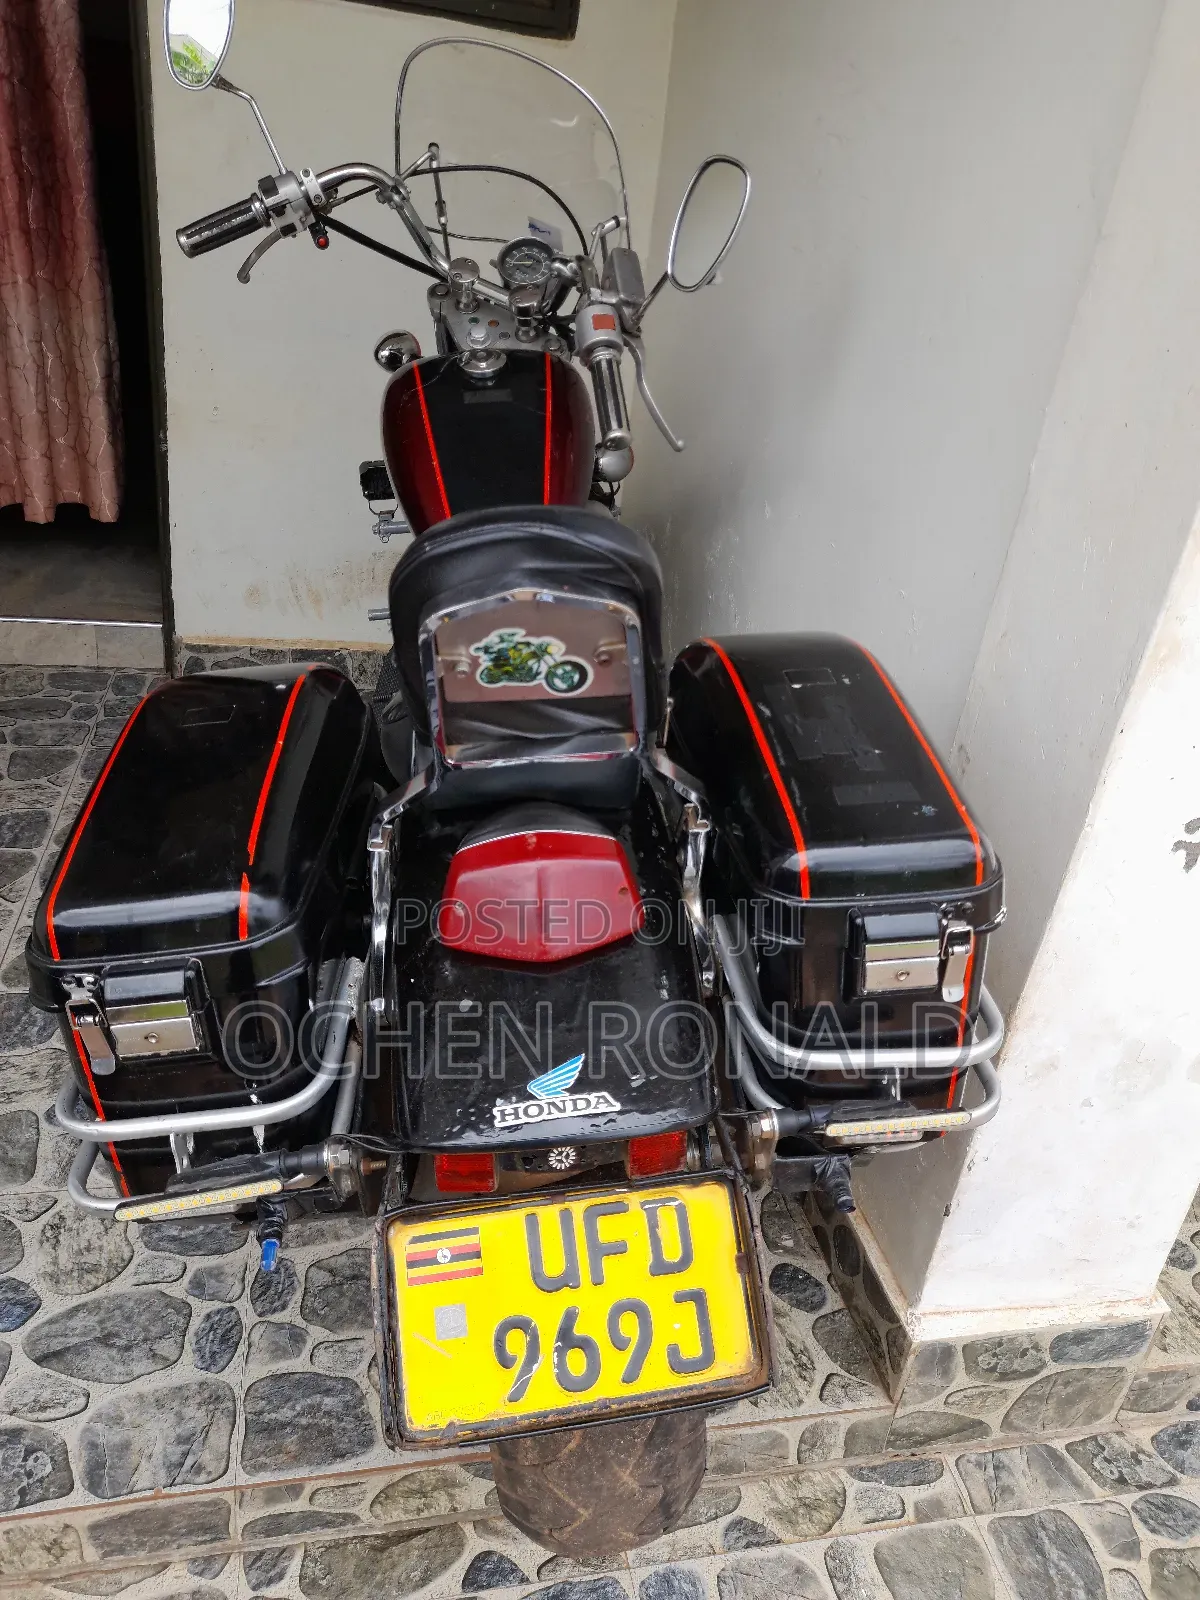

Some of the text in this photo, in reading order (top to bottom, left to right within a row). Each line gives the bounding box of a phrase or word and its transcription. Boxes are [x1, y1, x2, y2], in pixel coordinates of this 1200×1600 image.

[497, 1095, 617, 1123] HONDA
[525, 1197, 694, 1293] UFD
[494, 1288, 715, 1403] 969J
